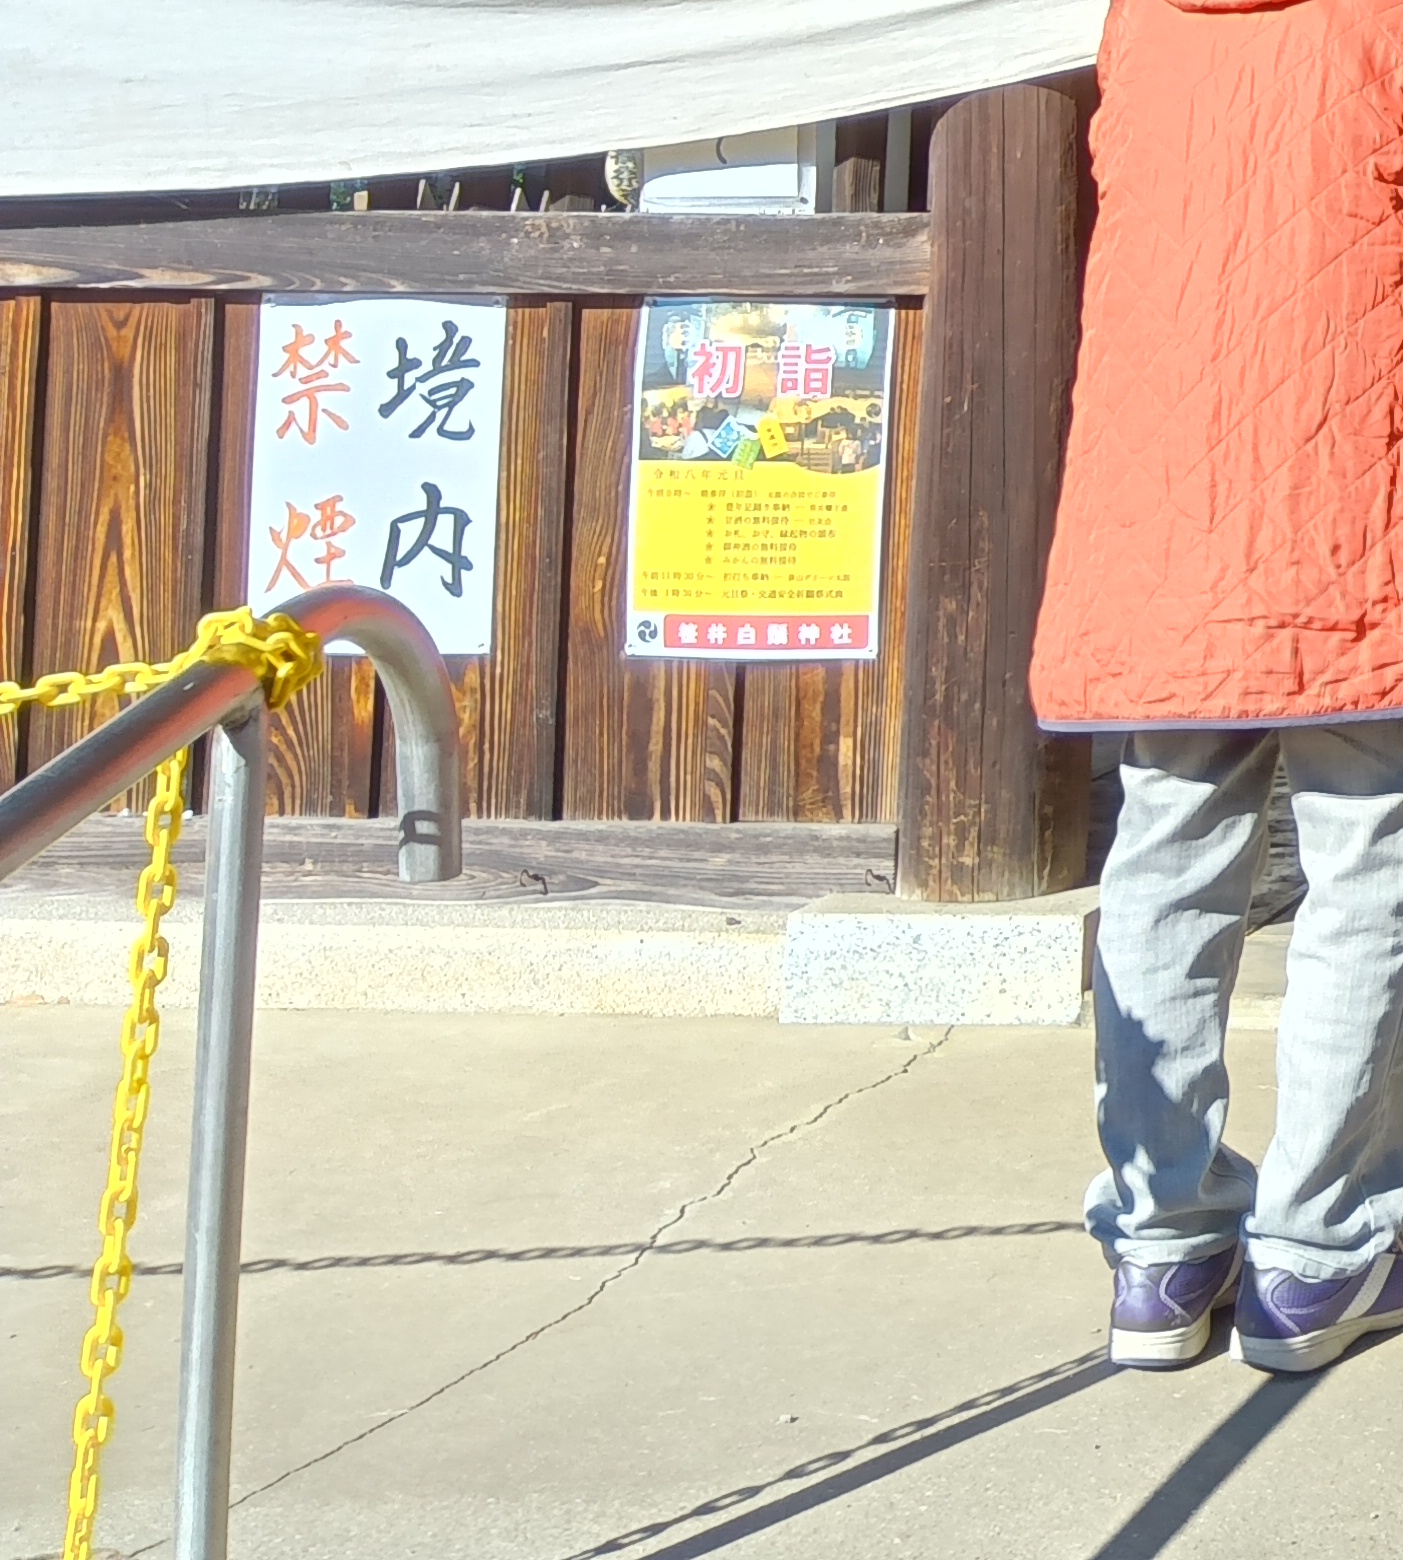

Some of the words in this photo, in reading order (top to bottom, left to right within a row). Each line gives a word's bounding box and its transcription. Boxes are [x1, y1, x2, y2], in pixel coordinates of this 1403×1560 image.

[263, 319, 361, 594] 禁煙
[377, 319, 481, 598] 境内
[689, 340, 835, 396] 初詣
